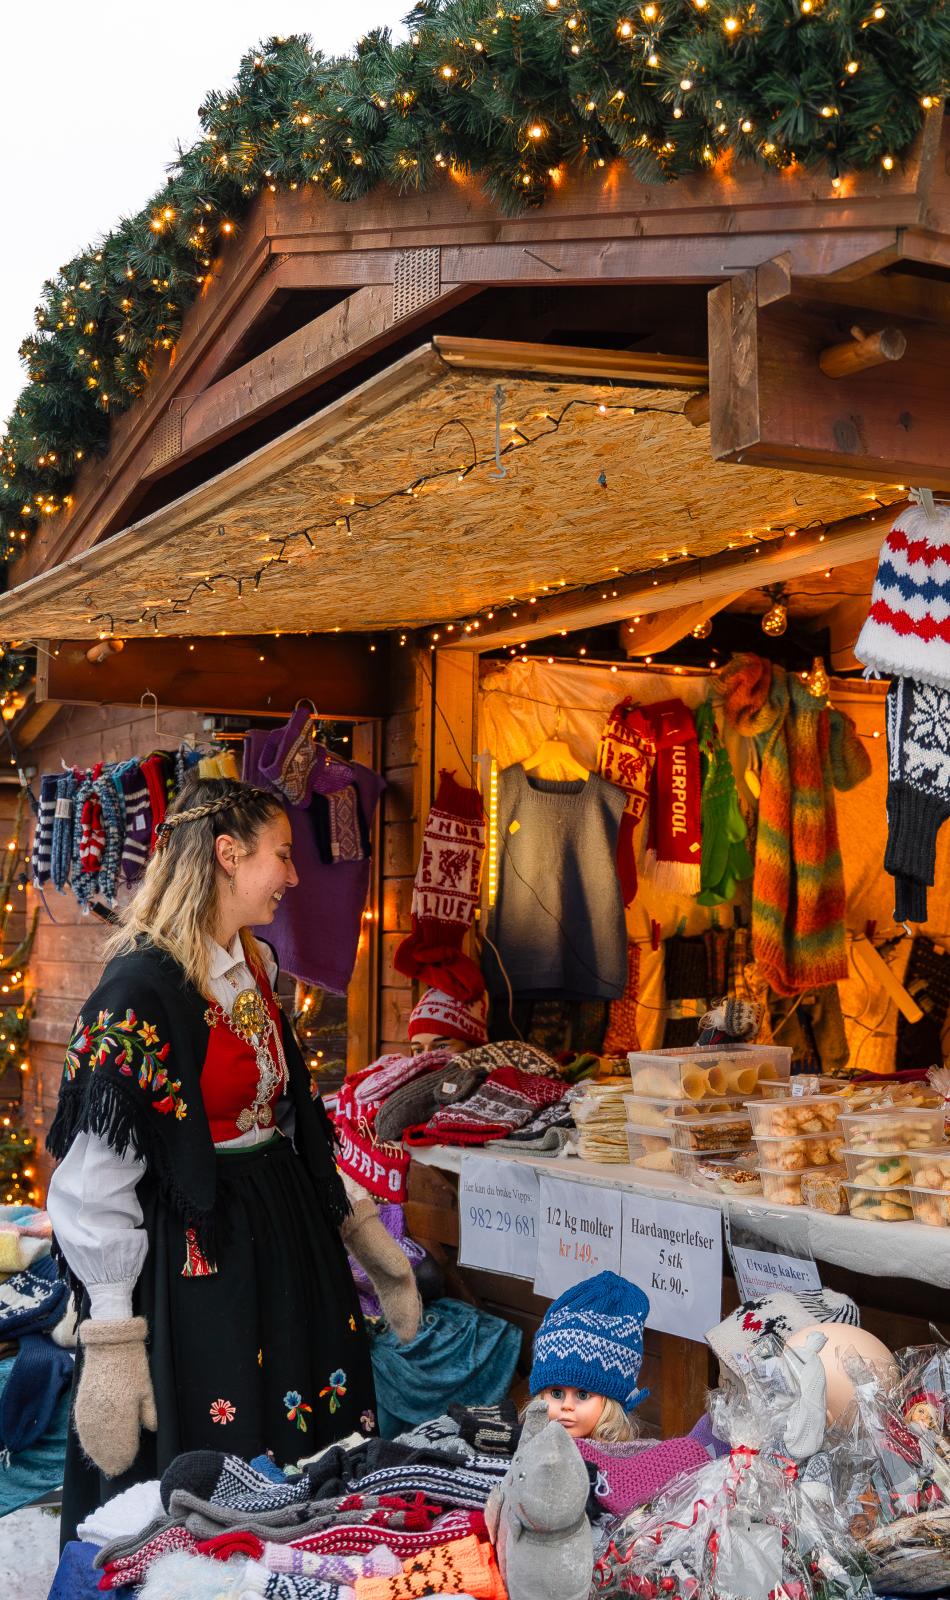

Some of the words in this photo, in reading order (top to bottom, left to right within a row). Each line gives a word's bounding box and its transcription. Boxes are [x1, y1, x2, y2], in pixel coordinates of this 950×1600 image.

[487, 1185, 495, 1196] du
[470, 1206, 492, 1229] 982
[496, 1211, 511, 1232] 29
[515, 1215, 536, 1238] 681
[547, 1207, 561, 1226] 1/2
[565, 1210, 577, 1235] kg
[580, 1217, 613, 1239] molter
[631, 1218, 714, 1250] Hardangerlefser
[559, 1238, 571, 1257] kr
[659, 1249, 666, 1265] 5
[667, 1253, 684, 1269] stk
[746, 1259, 778, 1279] Utvalg
[778, 1265, 810, 1282] kaker:
[651, 1272, 667, 1291] Kr.
